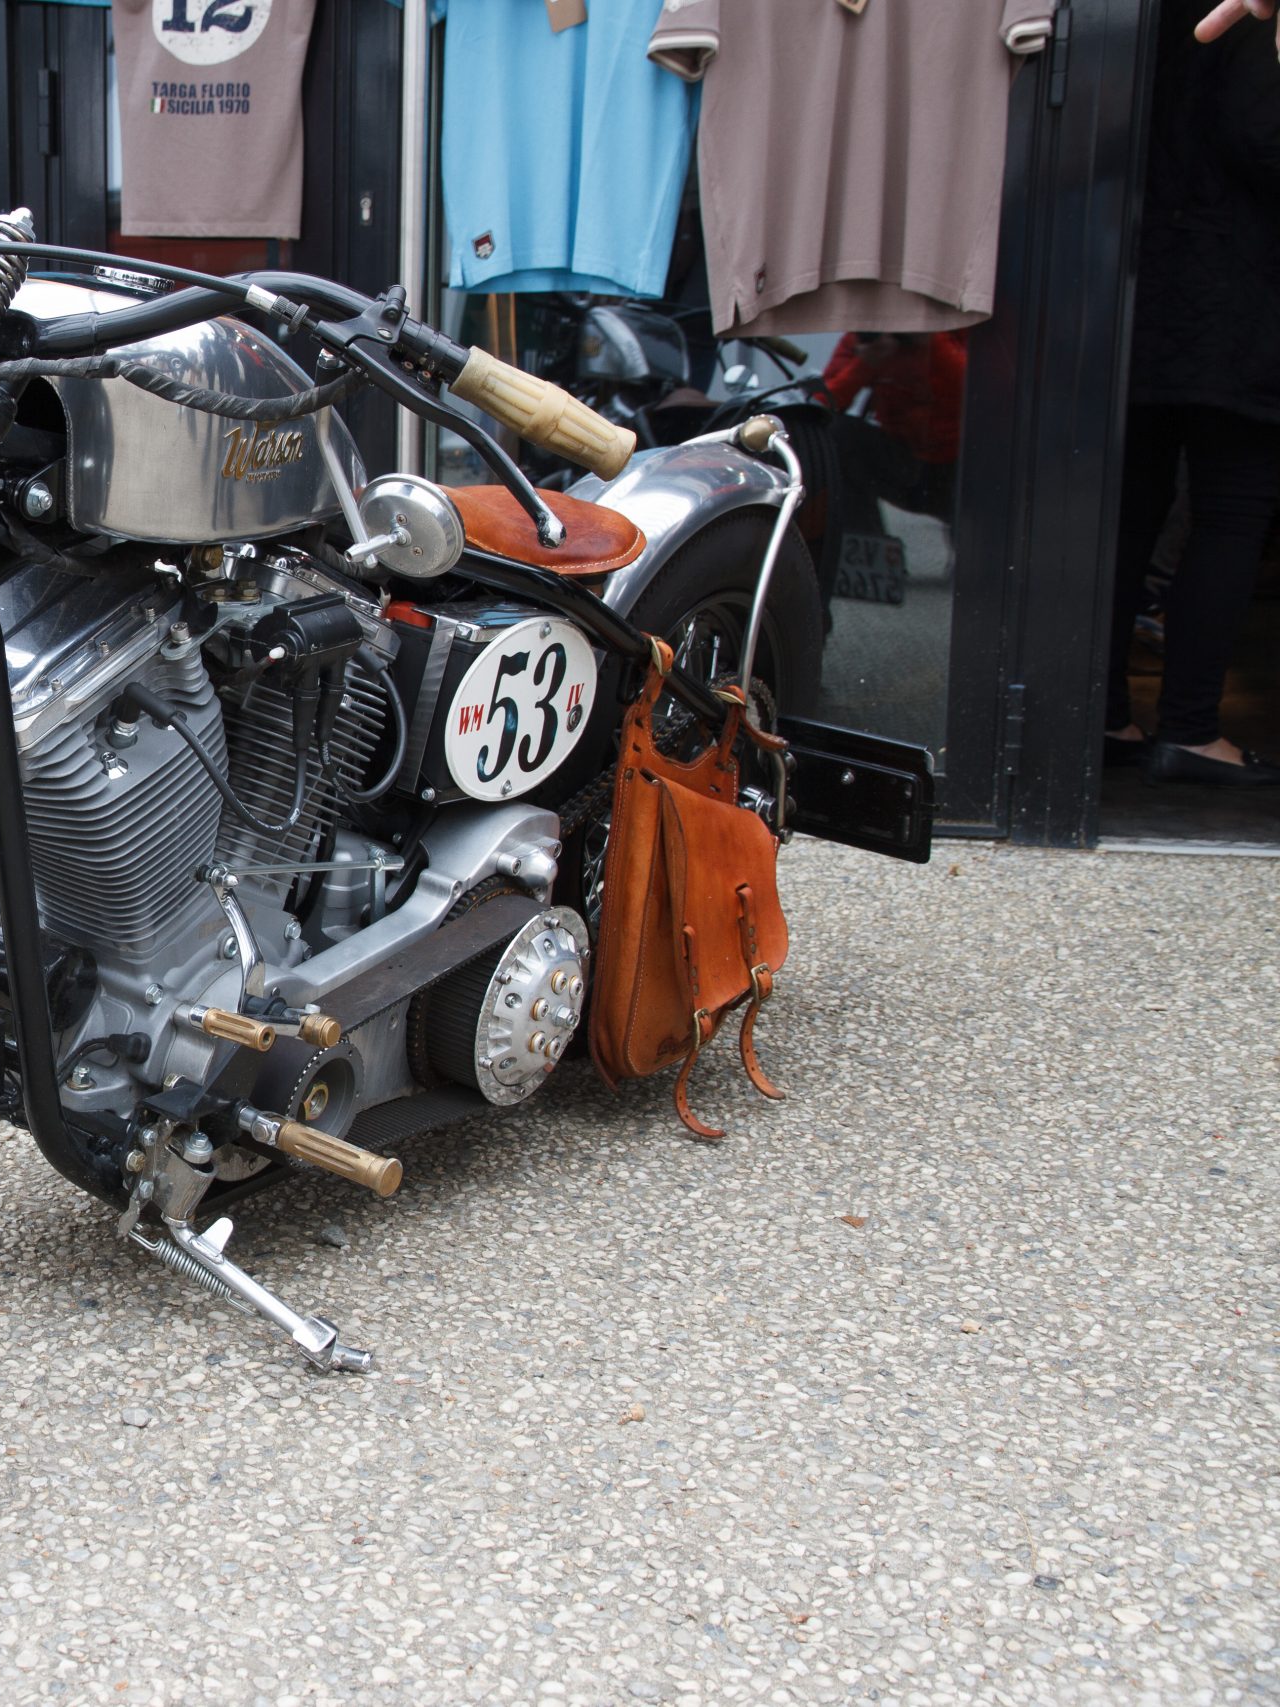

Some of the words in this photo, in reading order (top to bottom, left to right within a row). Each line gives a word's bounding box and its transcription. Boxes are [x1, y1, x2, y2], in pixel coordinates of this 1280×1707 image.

[162, 0, 253, 32] 12
[152, 82, 197, 99] TARGA
[201, 83, 251, 99] FLORIO
[167, 99, 215, 115] SICILIA
[219, 99, 250, 115] 1970
[459, 704, 485, 735] WM
[477, 642, 567, 783] 53
[566, 683, 585, 711] IV
